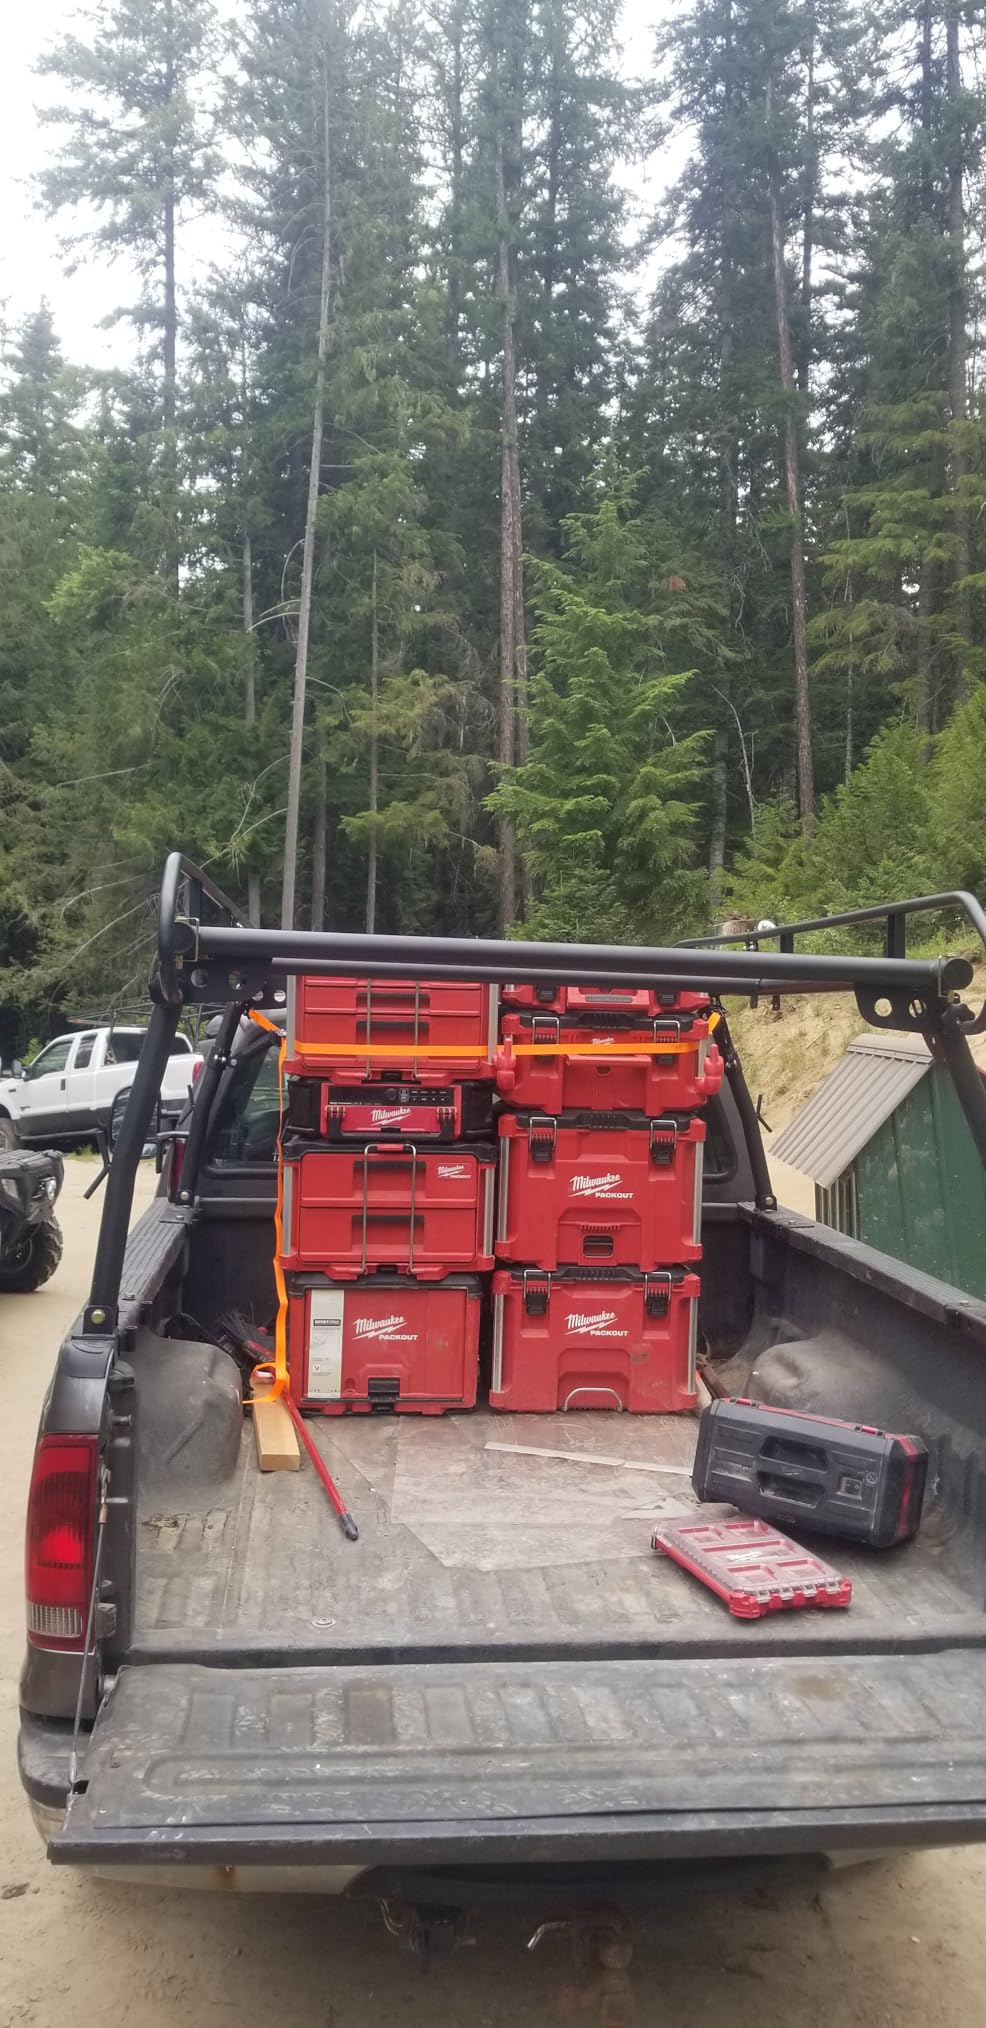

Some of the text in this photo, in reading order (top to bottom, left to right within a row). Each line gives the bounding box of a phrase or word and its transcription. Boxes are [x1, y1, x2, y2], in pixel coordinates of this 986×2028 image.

[370, 1107, 411, 1122] Milwaukee
[570, 1173, 621, 1191] Milwaukee
[352, 1315, 405, 1335] Milwaukee
[564, 1311, 617, 1329] Milwaukee
